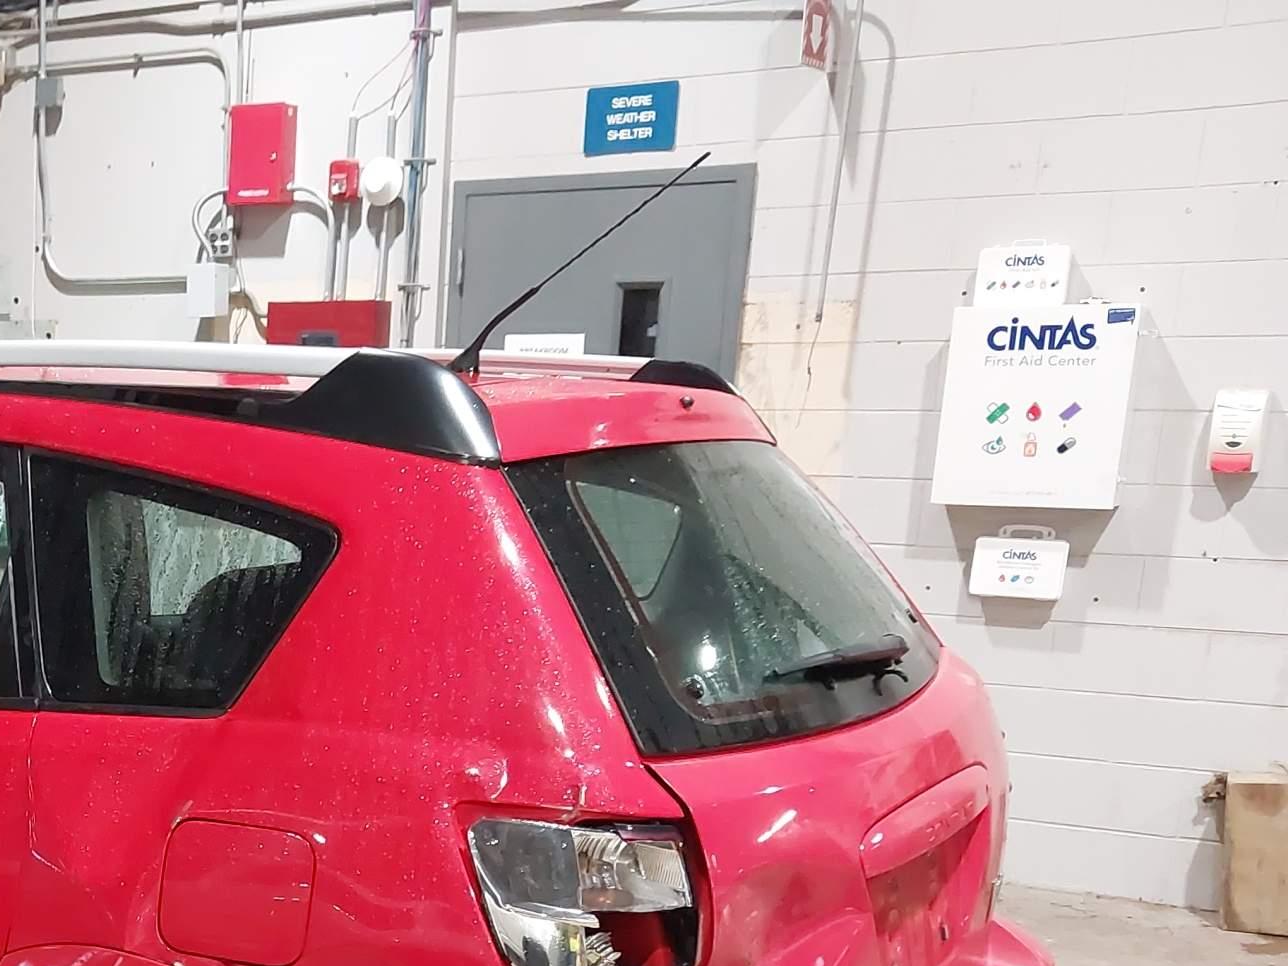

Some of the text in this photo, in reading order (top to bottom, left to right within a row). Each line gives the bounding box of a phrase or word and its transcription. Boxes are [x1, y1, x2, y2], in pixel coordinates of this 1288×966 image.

[611, 94, 653, 109] SEVERE
[606, 110, 656, 126] WEATHER
[606, 126, 653, 141] SHELTER
[984, 354, 1097, 367] First Aid Center
